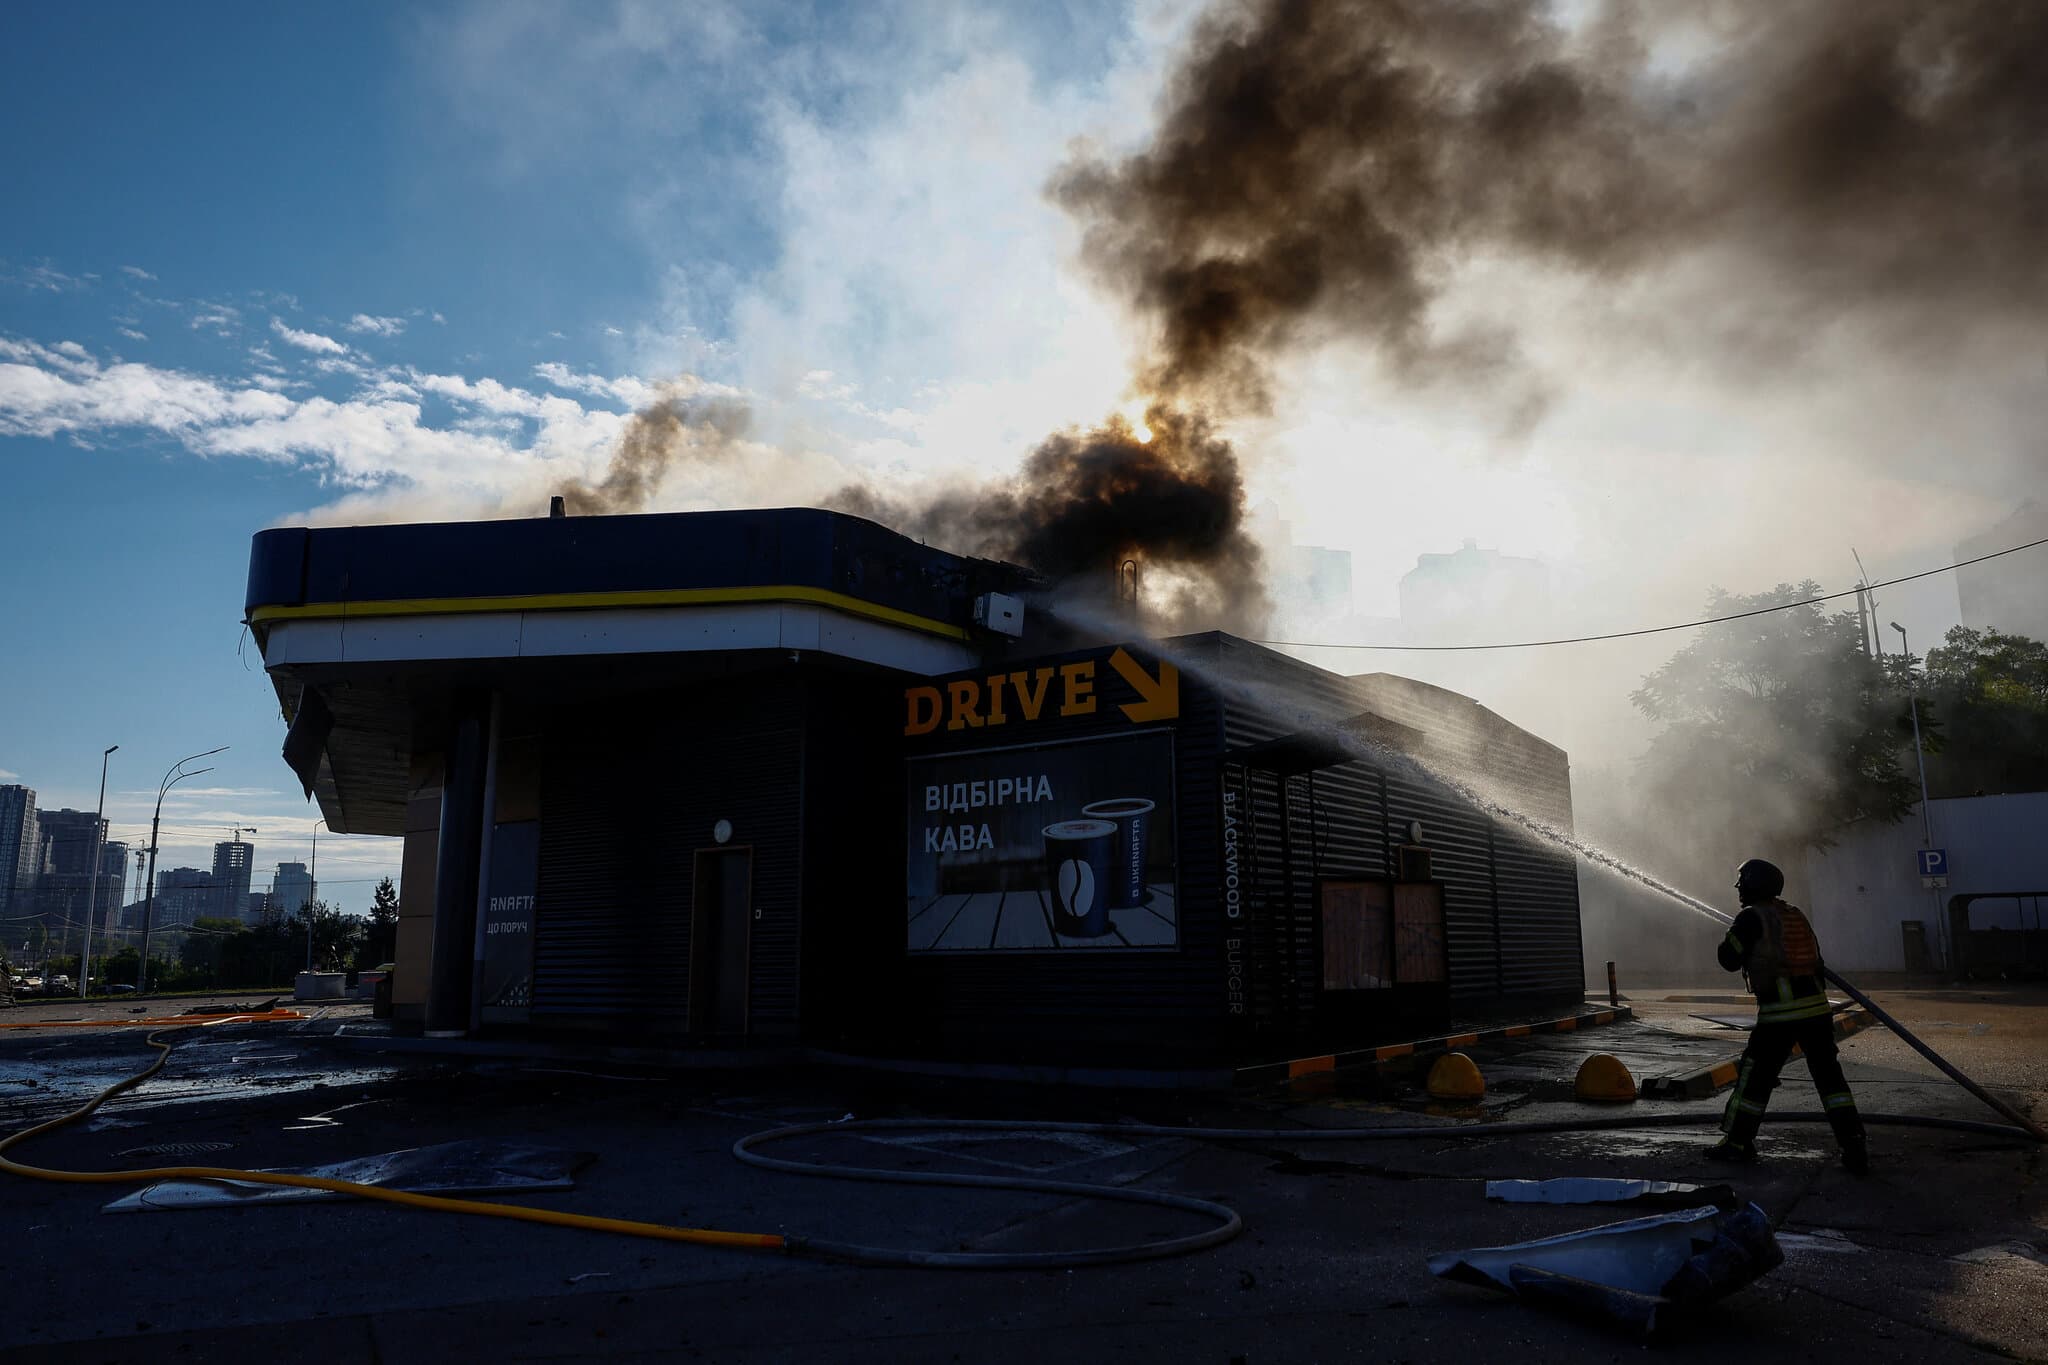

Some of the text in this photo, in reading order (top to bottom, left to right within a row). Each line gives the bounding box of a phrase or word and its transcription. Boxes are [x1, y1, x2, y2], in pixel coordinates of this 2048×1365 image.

[904, 660, 1097, 736] DRIVE
[925, 775, 1054, 814] ВІДБІРНА
[925, 823, 995, 853] КАВА
[1131, 819, 1141, 884] UKRNAFTA
[1925, 851, 1942, 873] P
[1223, 791, 1244, 1016] BLACKWOOD BURGER
[500, 921, 528, 934] ПОРУЧ
